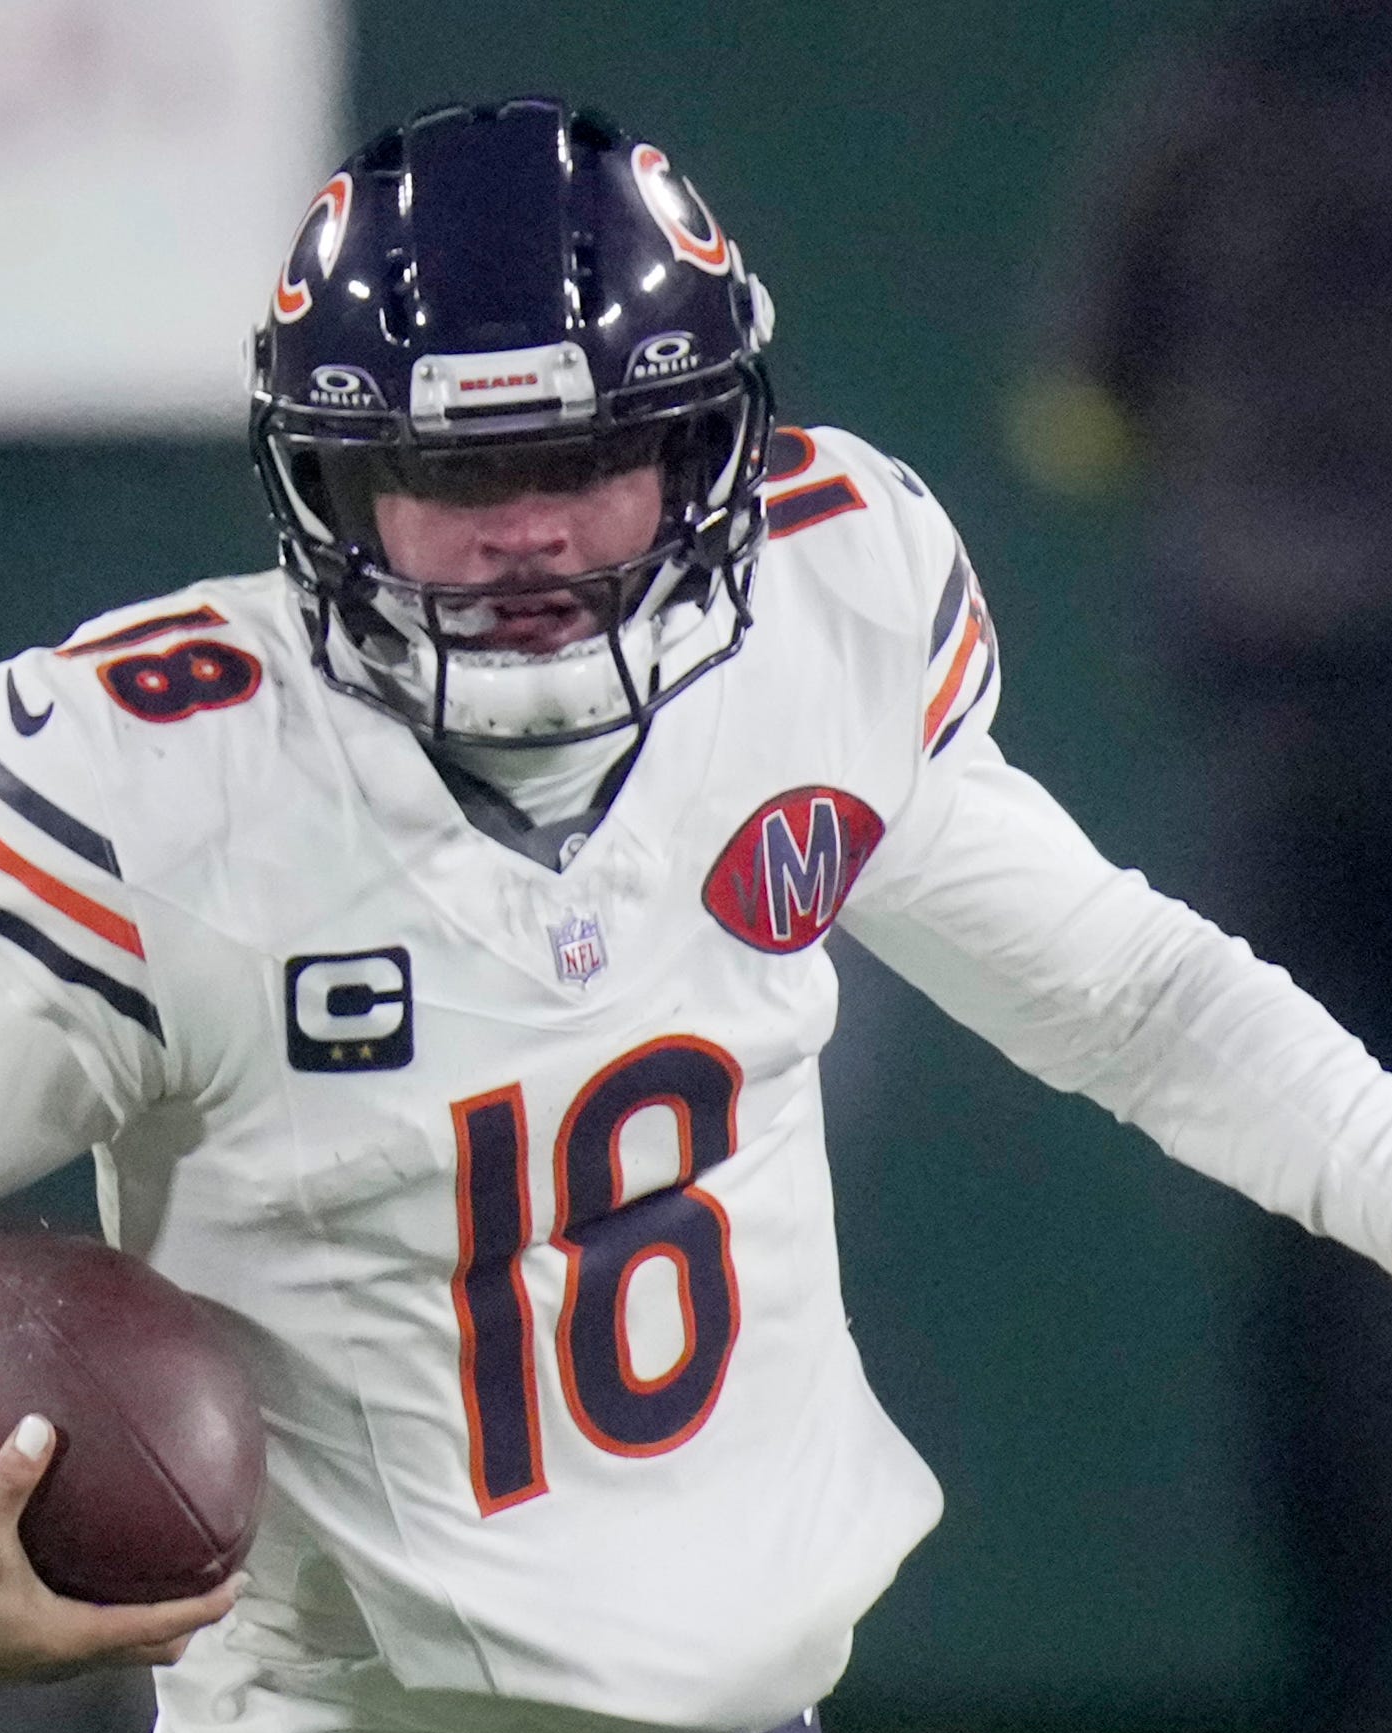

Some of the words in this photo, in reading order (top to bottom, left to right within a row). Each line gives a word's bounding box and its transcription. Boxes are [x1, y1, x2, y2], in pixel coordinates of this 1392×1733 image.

[459, 371, 539, 392] BEARS
[634, 352, 701, 379] OAKLEY
[309, 389, 375, 408] OAKLEY
[53, 604, 263, 724] 18
[762, 797, 841, 942] M
[564, 943, 600, 974] NFL
[295, 956, 405, 1042] C
[449, 1033, 744, 1519] 18
